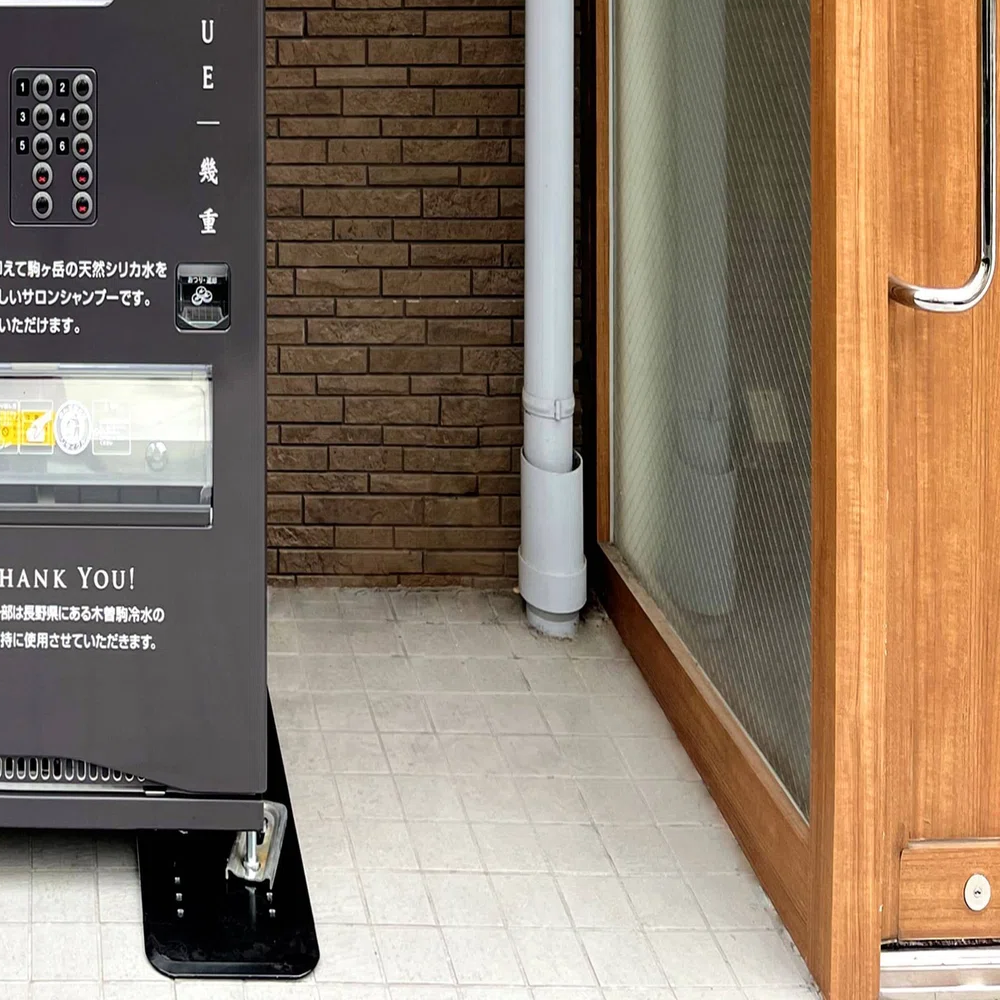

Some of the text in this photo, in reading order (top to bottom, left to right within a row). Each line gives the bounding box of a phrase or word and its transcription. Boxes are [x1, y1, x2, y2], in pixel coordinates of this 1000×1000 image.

[59, 82, 66, 93] 2
[20, 111, 26, 123] 3
[59, 112, 66, 123] 4
[20, 140, 26, 151] 5
[59, 140, 66, 152] 6
